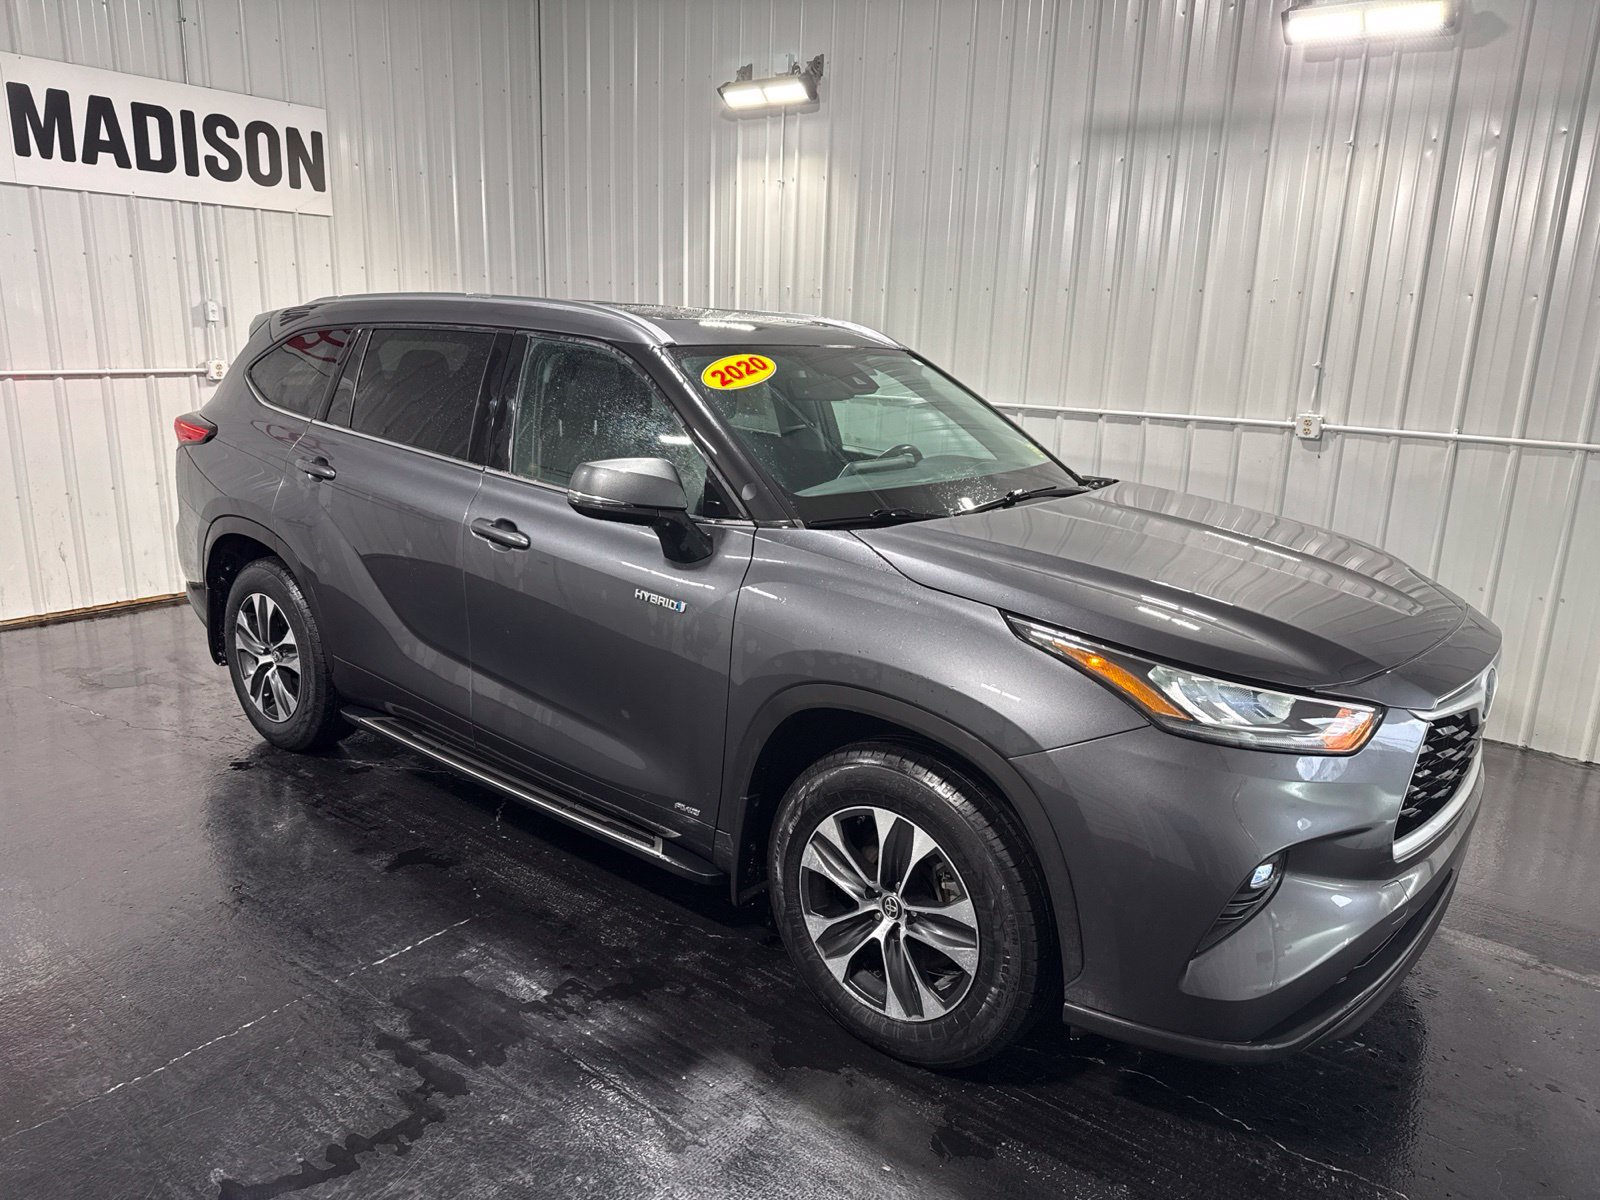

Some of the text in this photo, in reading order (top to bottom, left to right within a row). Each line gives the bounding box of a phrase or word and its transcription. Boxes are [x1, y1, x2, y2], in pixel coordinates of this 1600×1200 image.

[6, 81, 326, 192] MADISON
[711, 357, 768, 387] 2020
[634, 588, 677, 611] HYBRID
